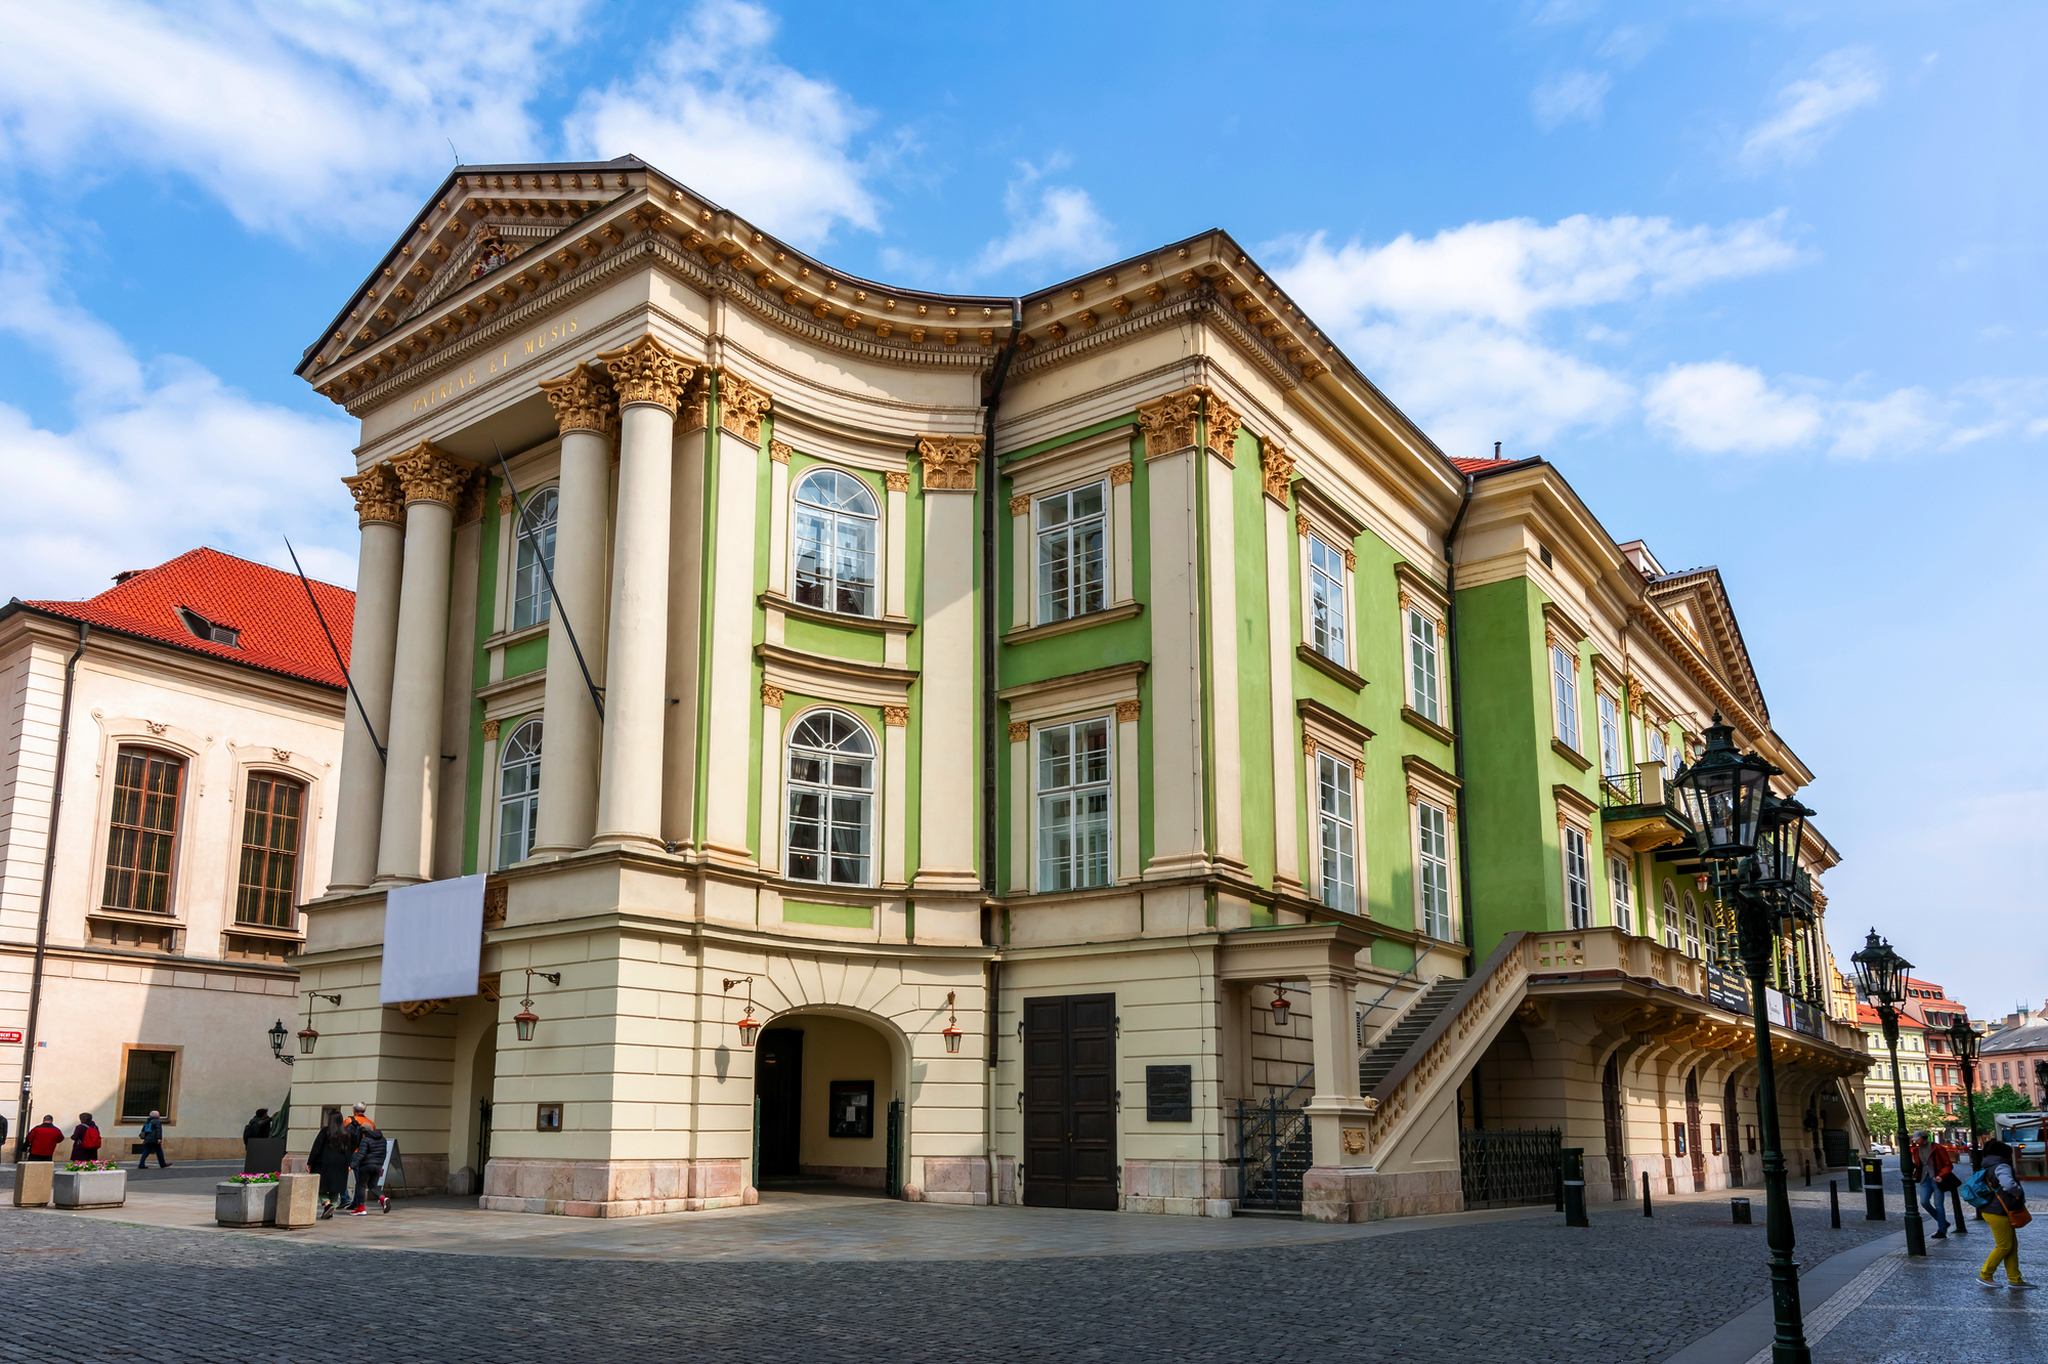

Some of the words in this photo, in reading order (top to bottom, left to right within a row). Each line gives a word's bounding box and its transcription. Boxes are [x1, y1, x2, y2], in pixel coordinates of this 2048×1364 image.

[413, 369, 476, 413] PATRIAE
[490, 351, 510, 374] ET
[524, 316, 578, 355] MUSIS
